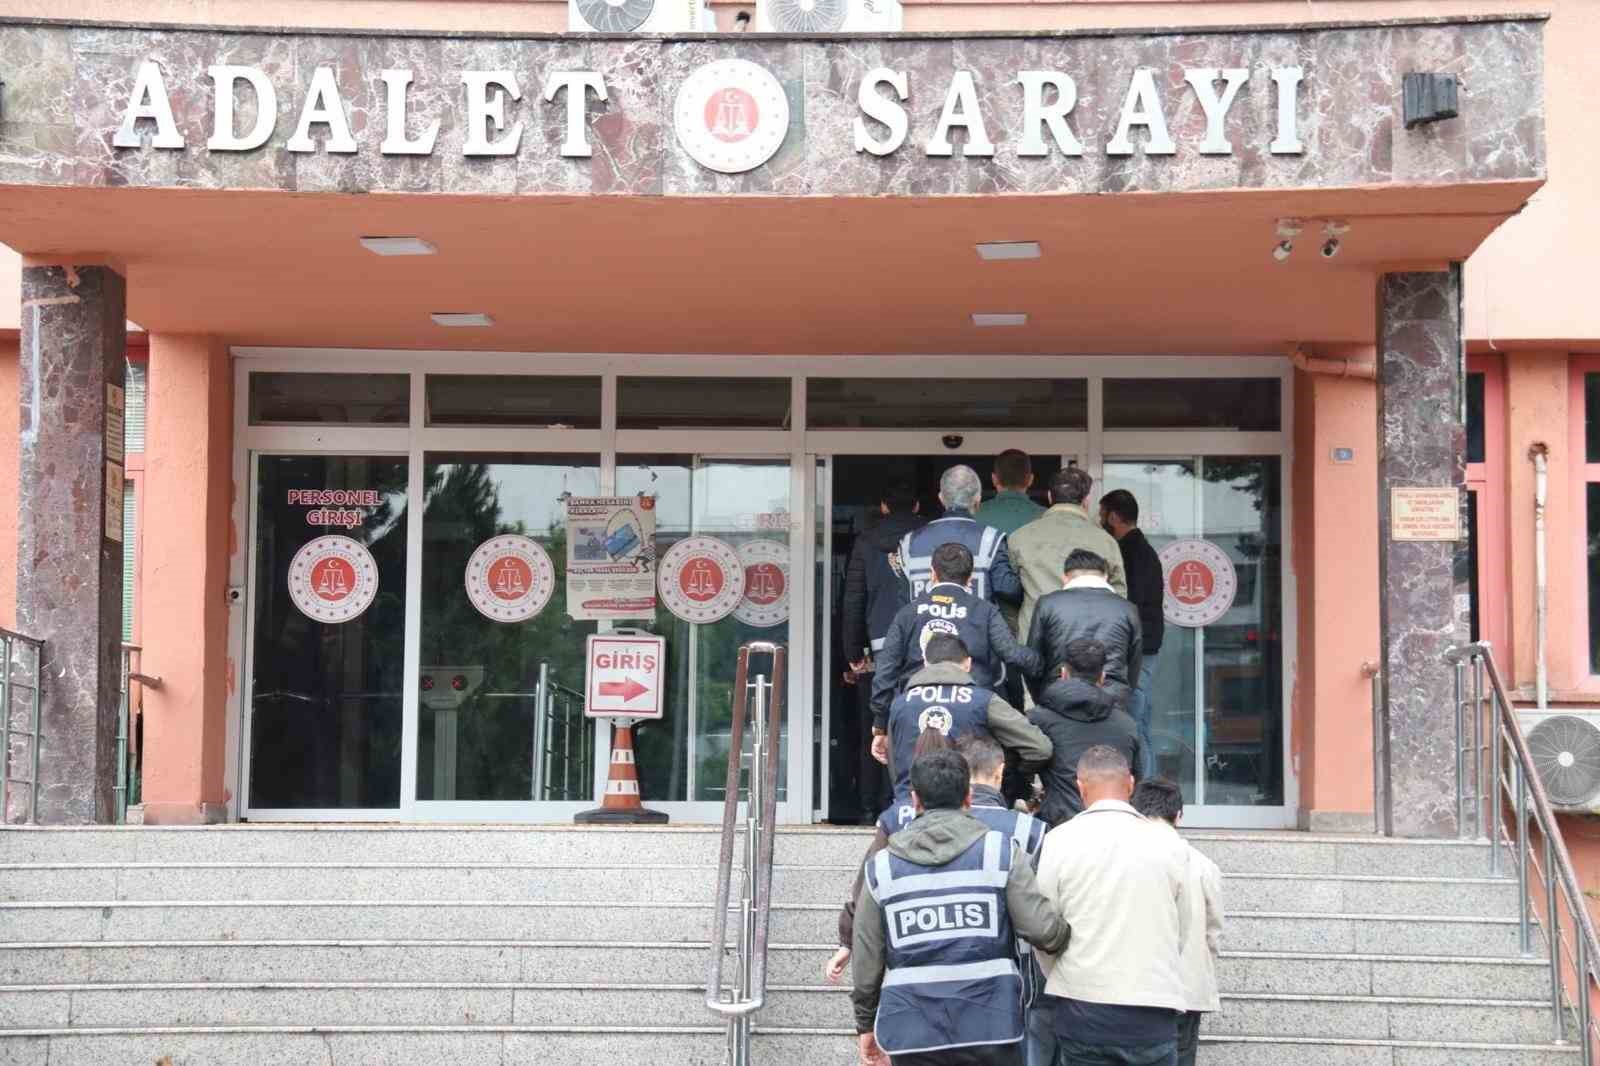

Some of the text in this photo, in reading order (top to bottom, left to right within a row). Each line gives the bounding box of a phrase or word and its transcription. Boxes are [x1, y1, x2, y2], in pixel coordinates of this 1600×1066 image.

[113, 61, 1303, 157] ADALET SARAYI
[287, 489, 384, 505] PERSONEL
[306, 507, 363, 529] GİRİŞİ
[917, 603, 967, 618] POLİS
[596, 650, 656, 673] GİRİŞ
[899, 904, 985, 936] POLİS
